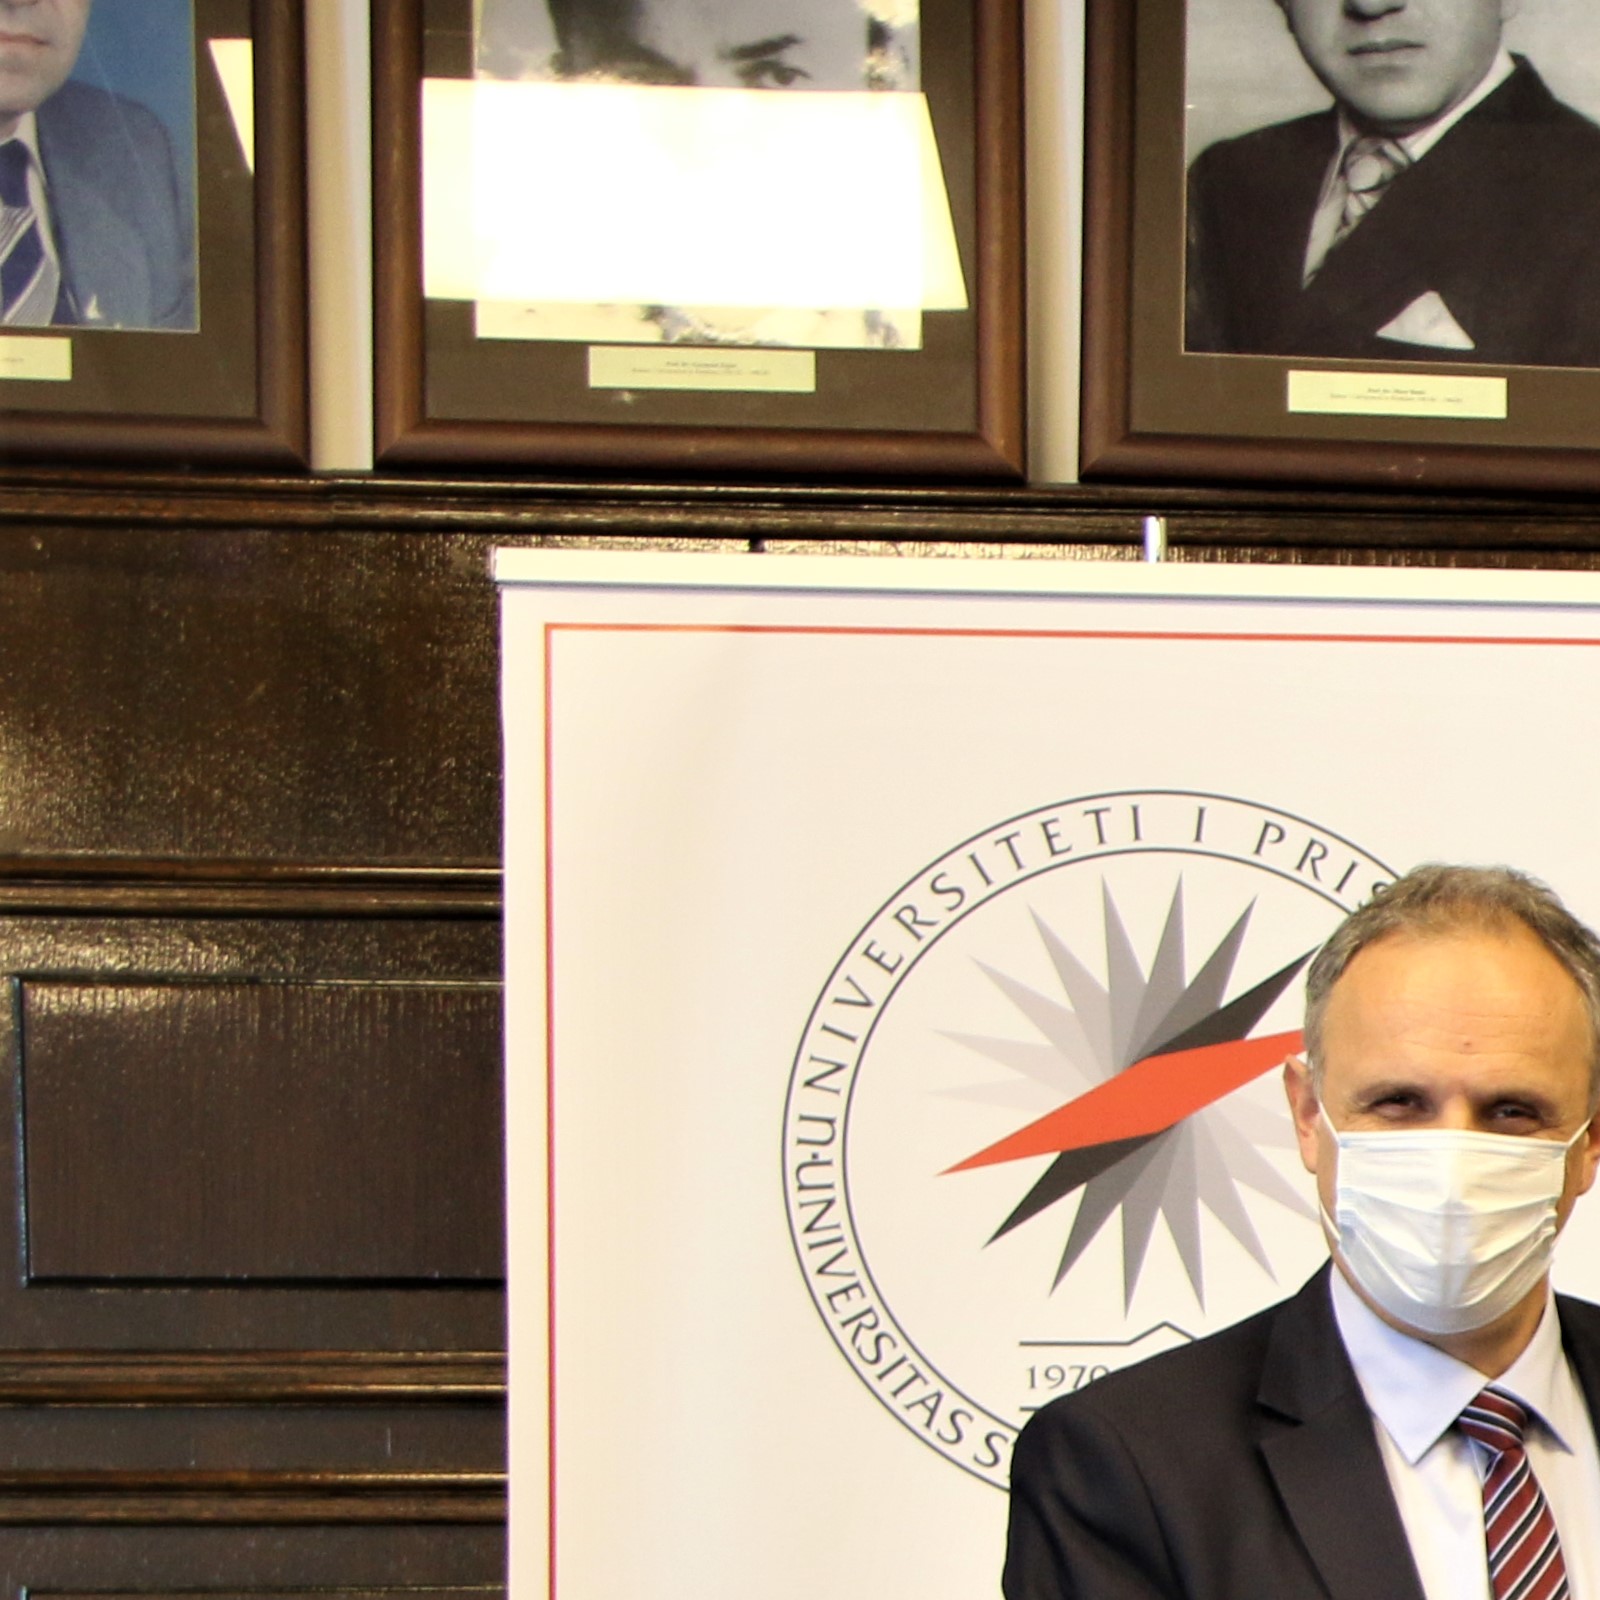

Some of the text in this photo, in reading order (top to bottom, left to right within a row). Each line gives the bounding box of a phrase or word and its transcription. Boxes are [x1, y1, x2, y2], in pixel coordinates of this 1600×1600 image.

[796, 804, 1142, 1149] UNIVERSITETI
[1193, 806, 1206, 843] I
[796, 1158, 974, 1446] UNIVERSITAS
